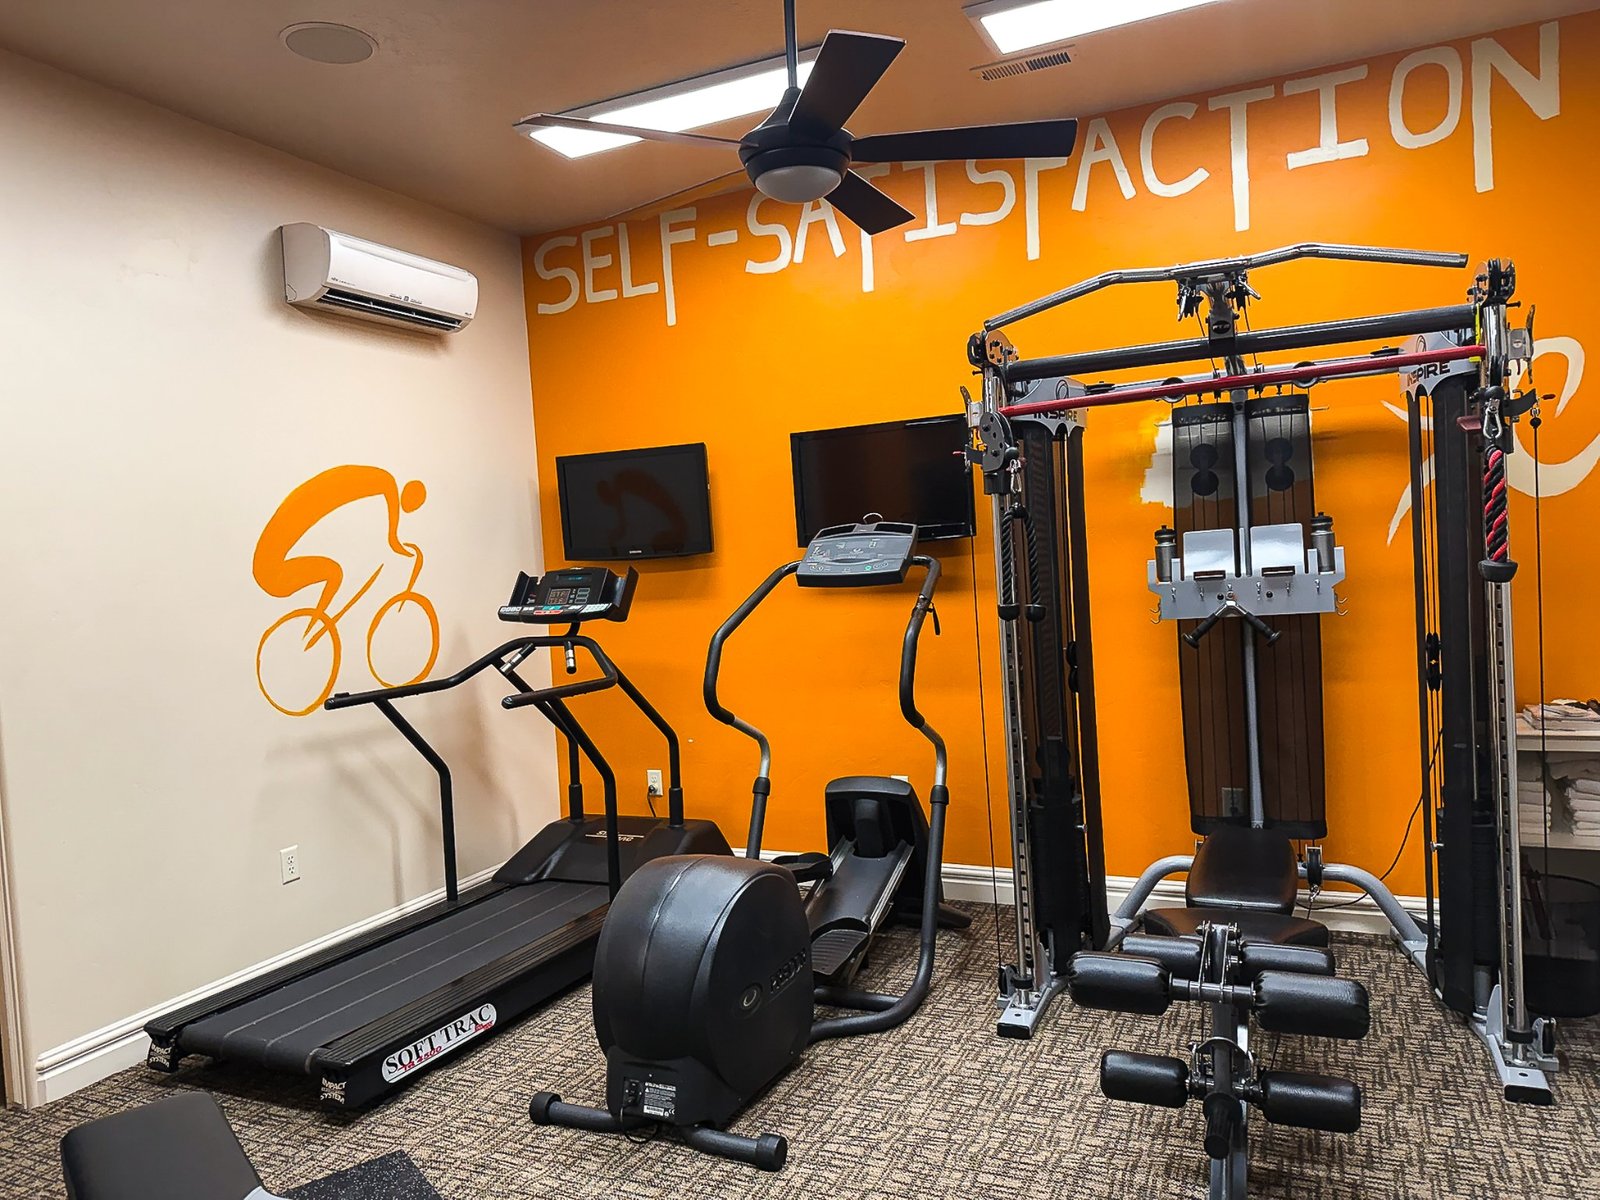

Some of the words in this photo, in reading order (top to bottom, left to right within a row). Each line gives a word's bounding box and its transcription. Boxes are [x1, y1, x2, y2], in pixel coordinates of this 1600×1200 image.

[385, 1034, 438, 1075] SOFT
[439, 1004, 492, 1044] TRAC
[322, 1077, 347, 1090] IMPACT
[320, 1092, 345, 1105] SYSTEM
